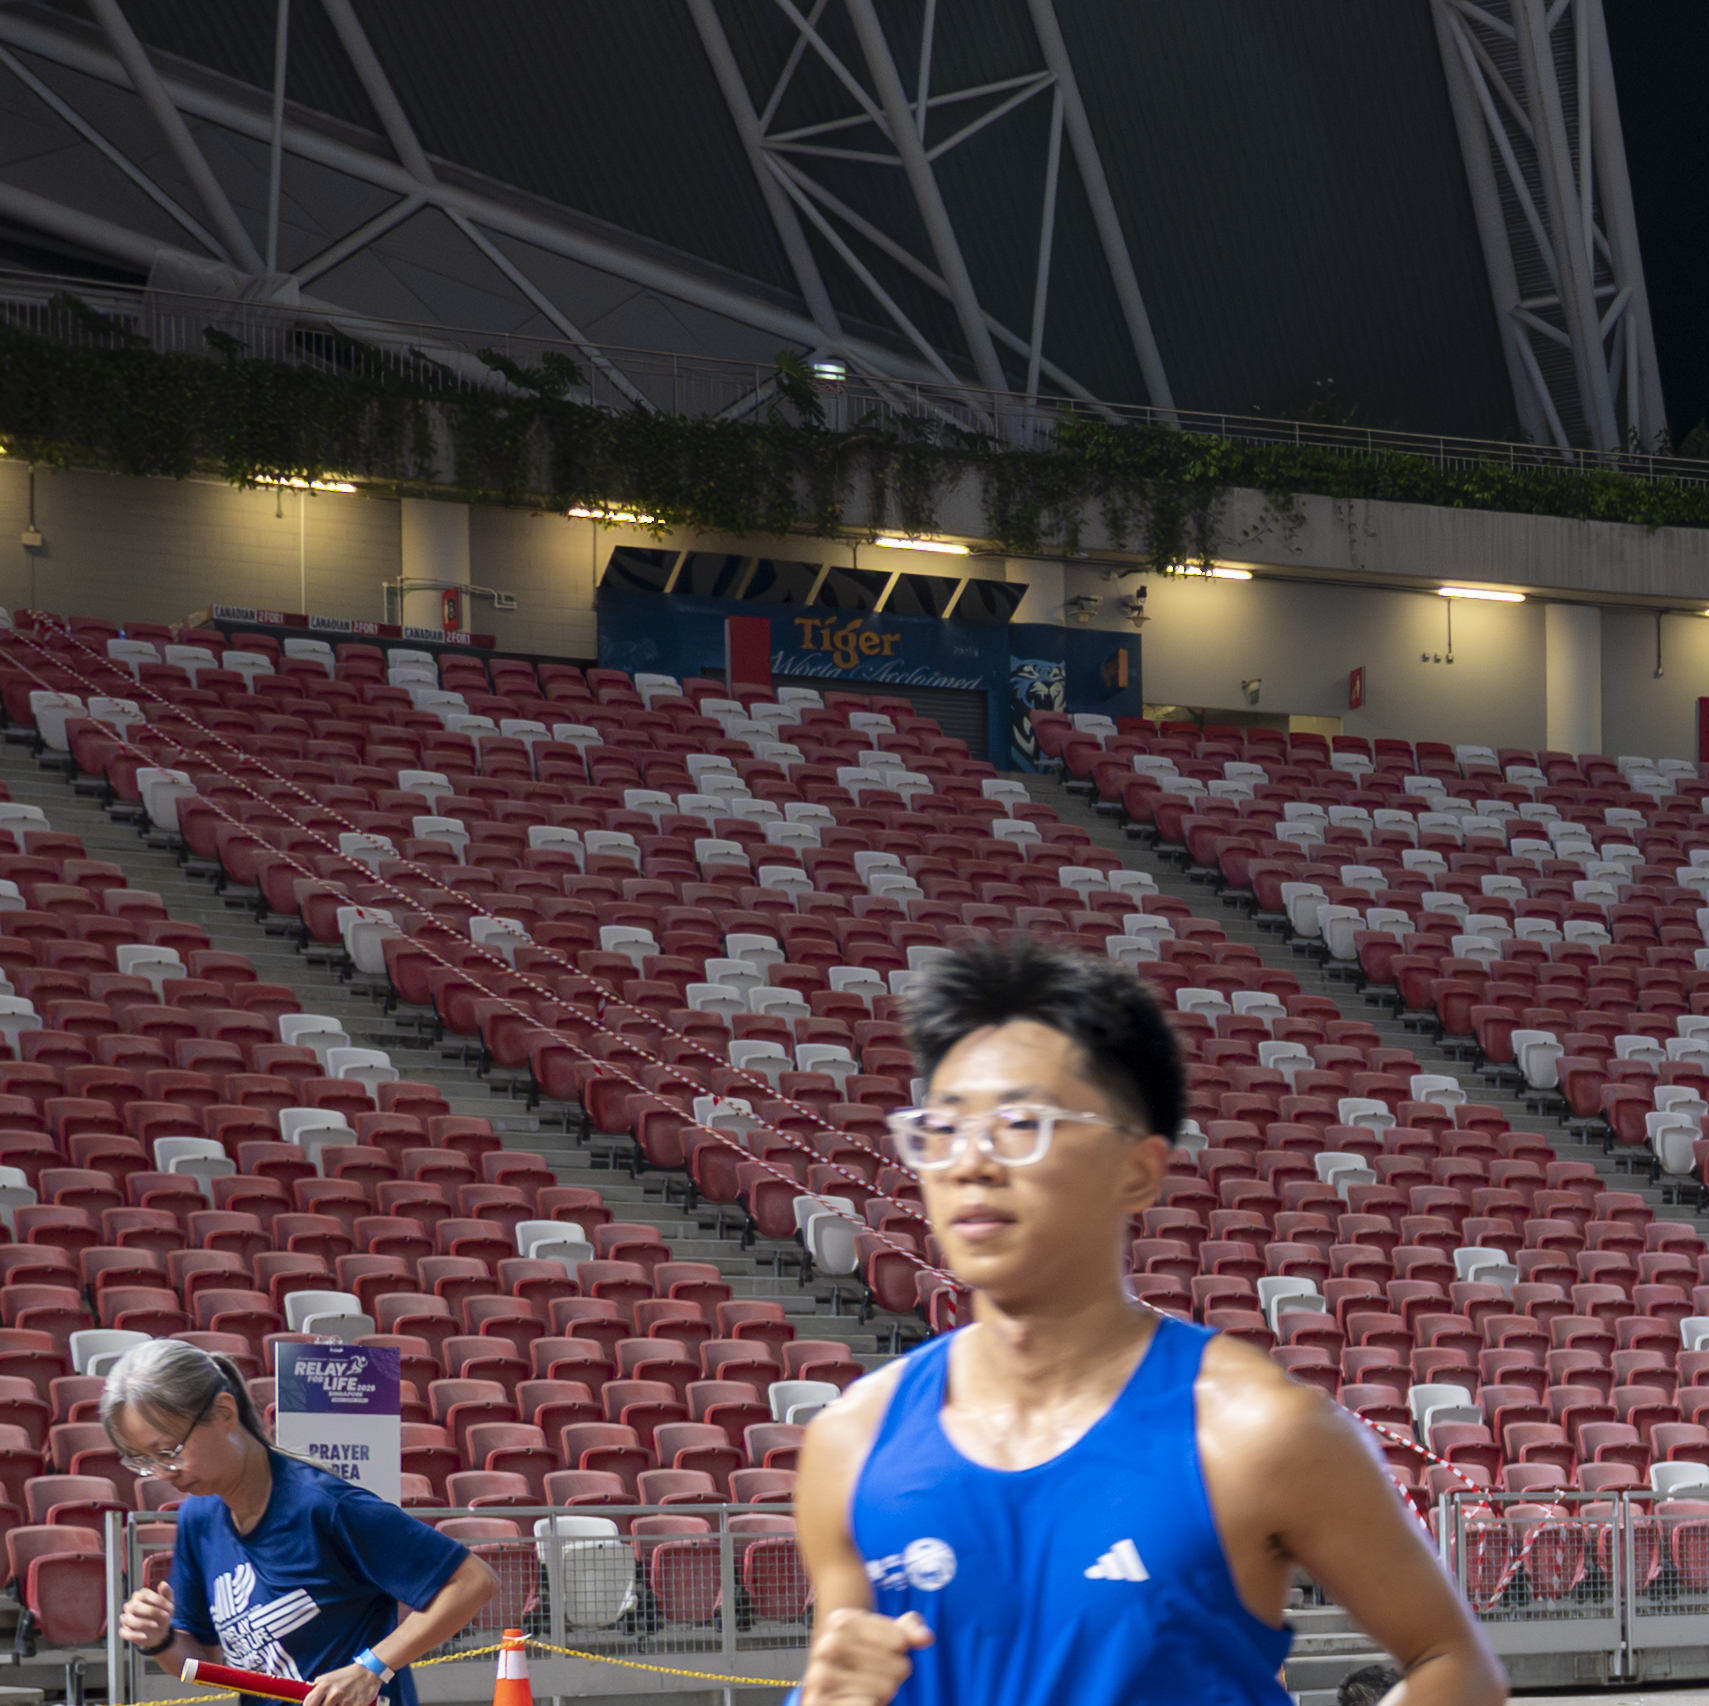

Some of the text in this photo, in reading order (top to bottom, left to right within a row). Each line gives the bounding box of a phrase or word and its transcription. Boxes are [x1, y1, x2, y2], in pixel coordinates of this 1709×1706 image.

[214, 606, 257, 621] CANADIAN
[310, 616, 351, 631] CANADIAN
[404, 627, 443, 642] CANADIAN
[794, 616, 901, 670] Tiger
[849, 658, 984, 691] Acclaimed
[294, 1361, 348, 1376] RELAY
[323, 1377, 359, 1391] LIFE
[309, 1444, 370, 1461] PRAYER
[331, 1463, 361, 1480] REA
